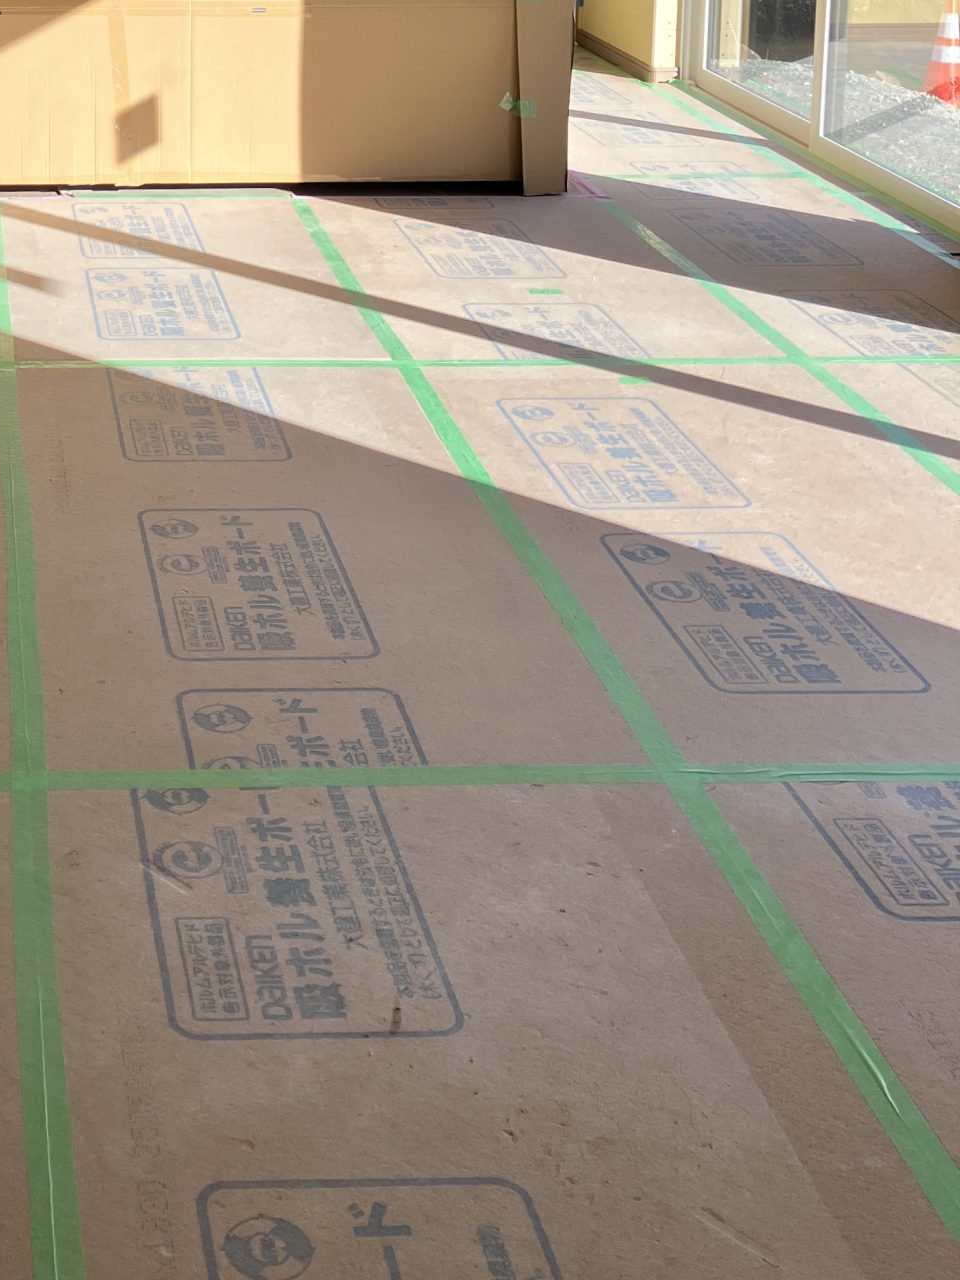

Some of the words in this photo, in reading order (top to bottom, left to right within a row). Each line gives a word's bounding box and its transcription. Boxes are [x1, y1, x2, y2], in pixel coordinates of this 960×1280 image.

[217, 515, 299, 651] 吸ホル養生ボード
